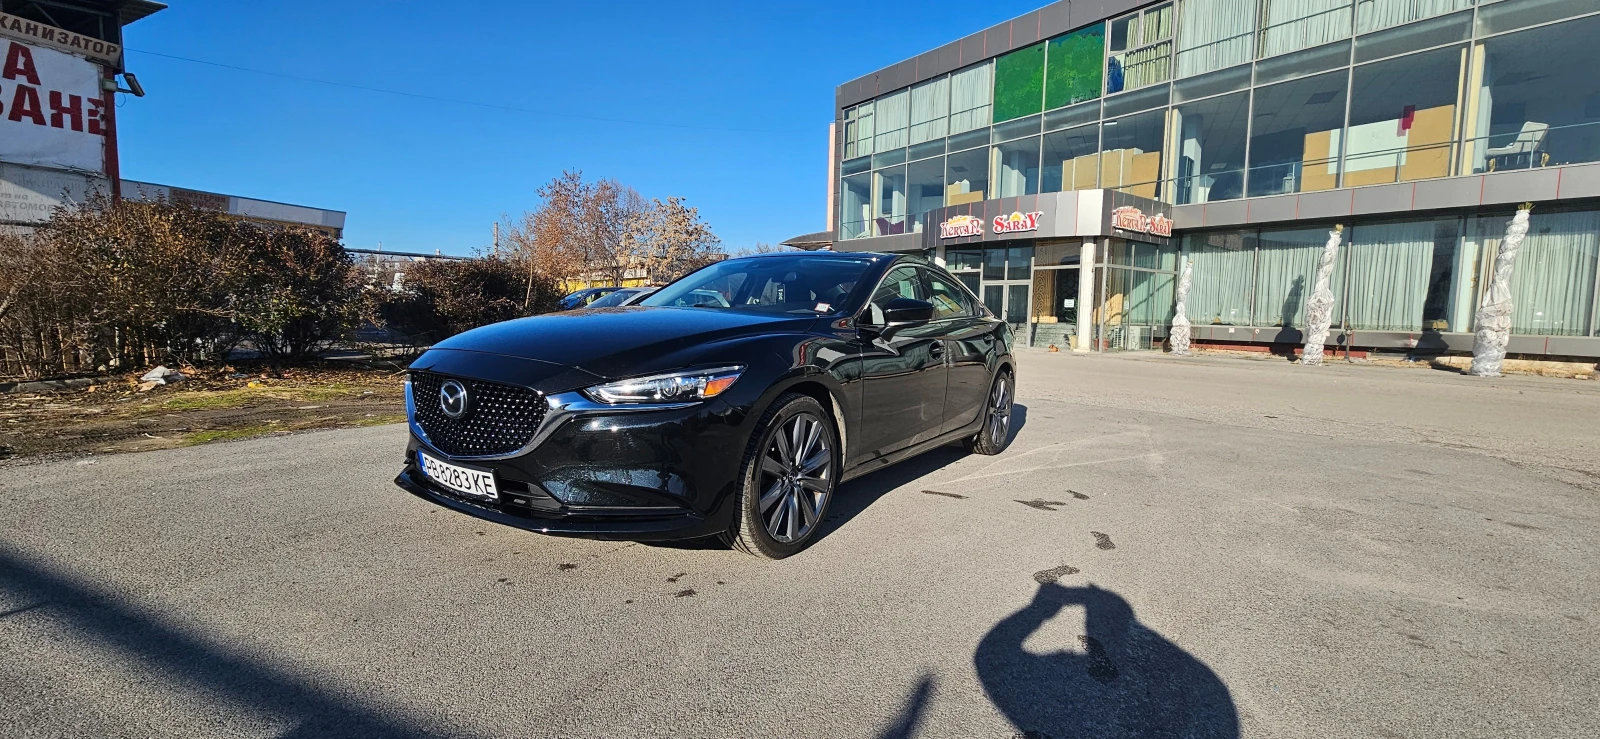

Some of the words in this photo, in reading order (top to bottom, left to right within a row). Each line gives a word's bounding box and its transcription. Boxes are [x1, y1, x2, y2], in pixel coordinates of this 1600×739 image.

[0, 84, 108, 136] АНЕ
[993, 212, 1041, 233] SARAY
[1150, 215, 1174, 236] SARAY
[439, 463, 472, 491] 8283
[472, 472, 496, 496] KE
